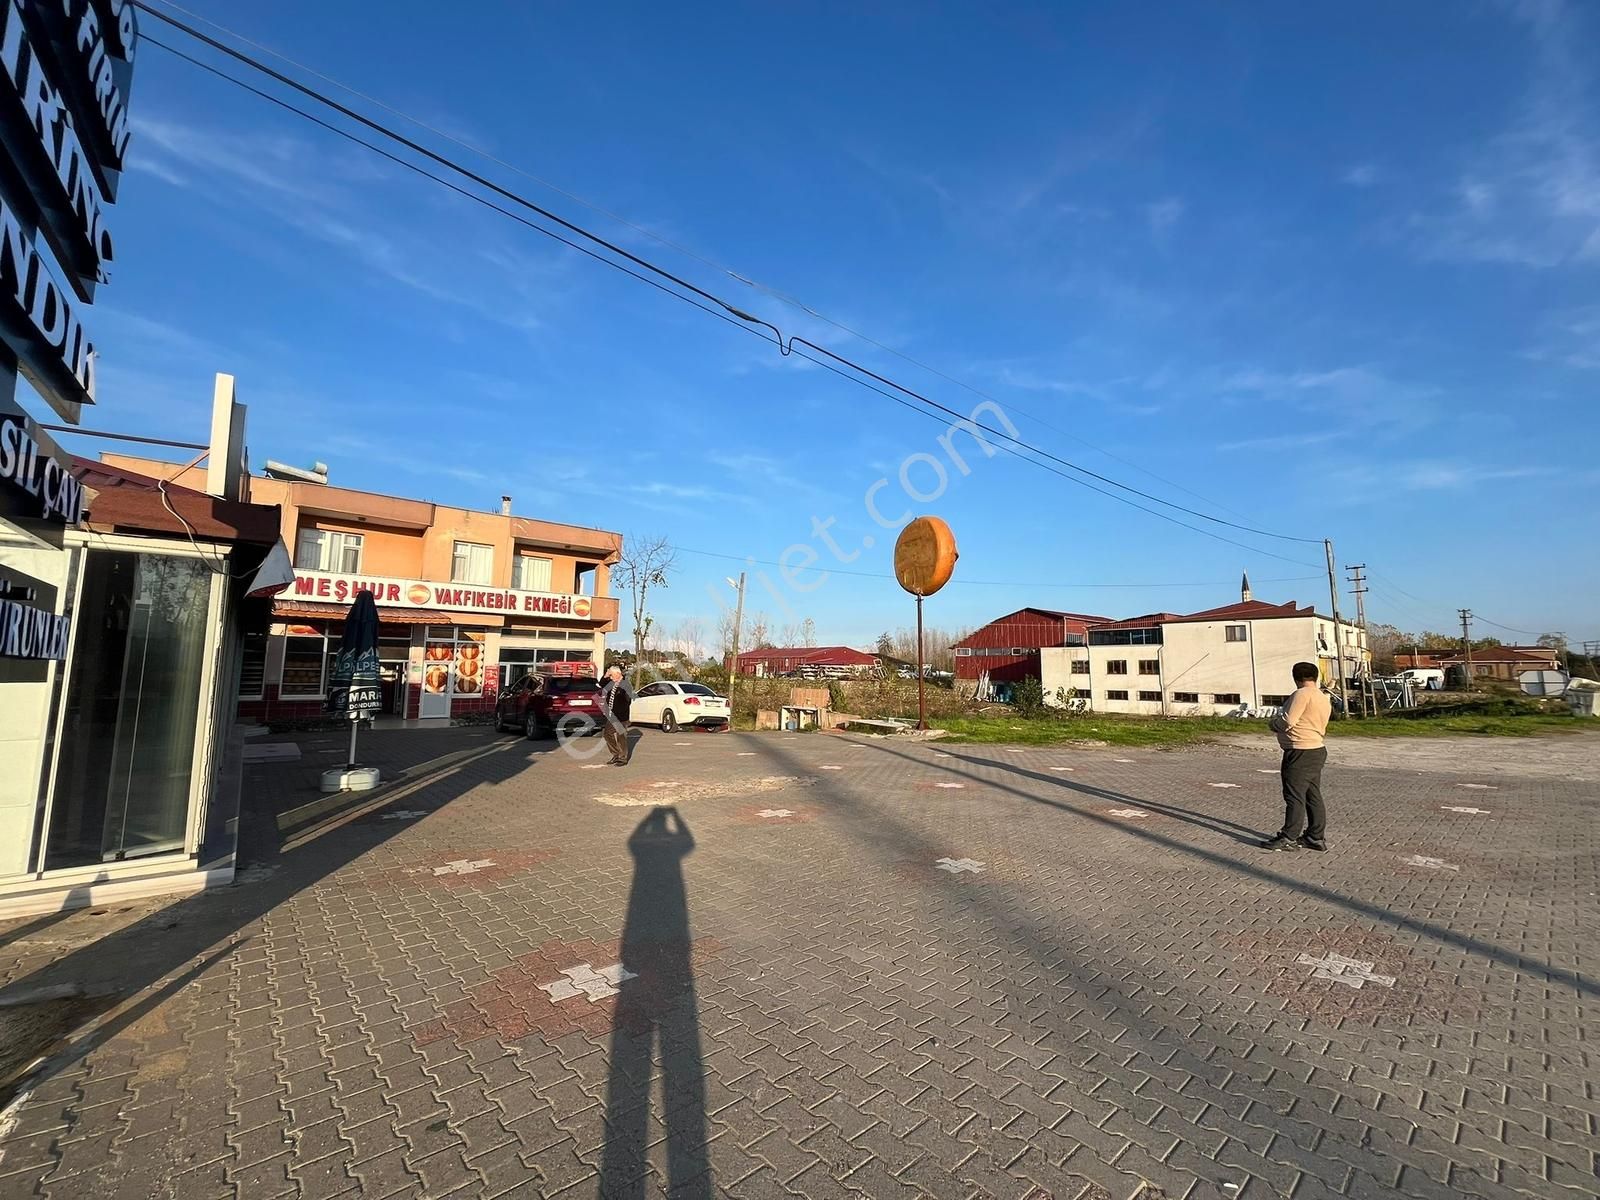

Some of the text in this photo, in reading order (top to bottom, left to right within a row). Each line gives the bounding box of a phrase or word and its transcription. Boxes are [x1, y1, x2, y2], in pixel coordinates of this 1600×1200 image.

[295, 576, 572, 616] MEŞHUR VAKFIKEBİR EKMEĞİ
